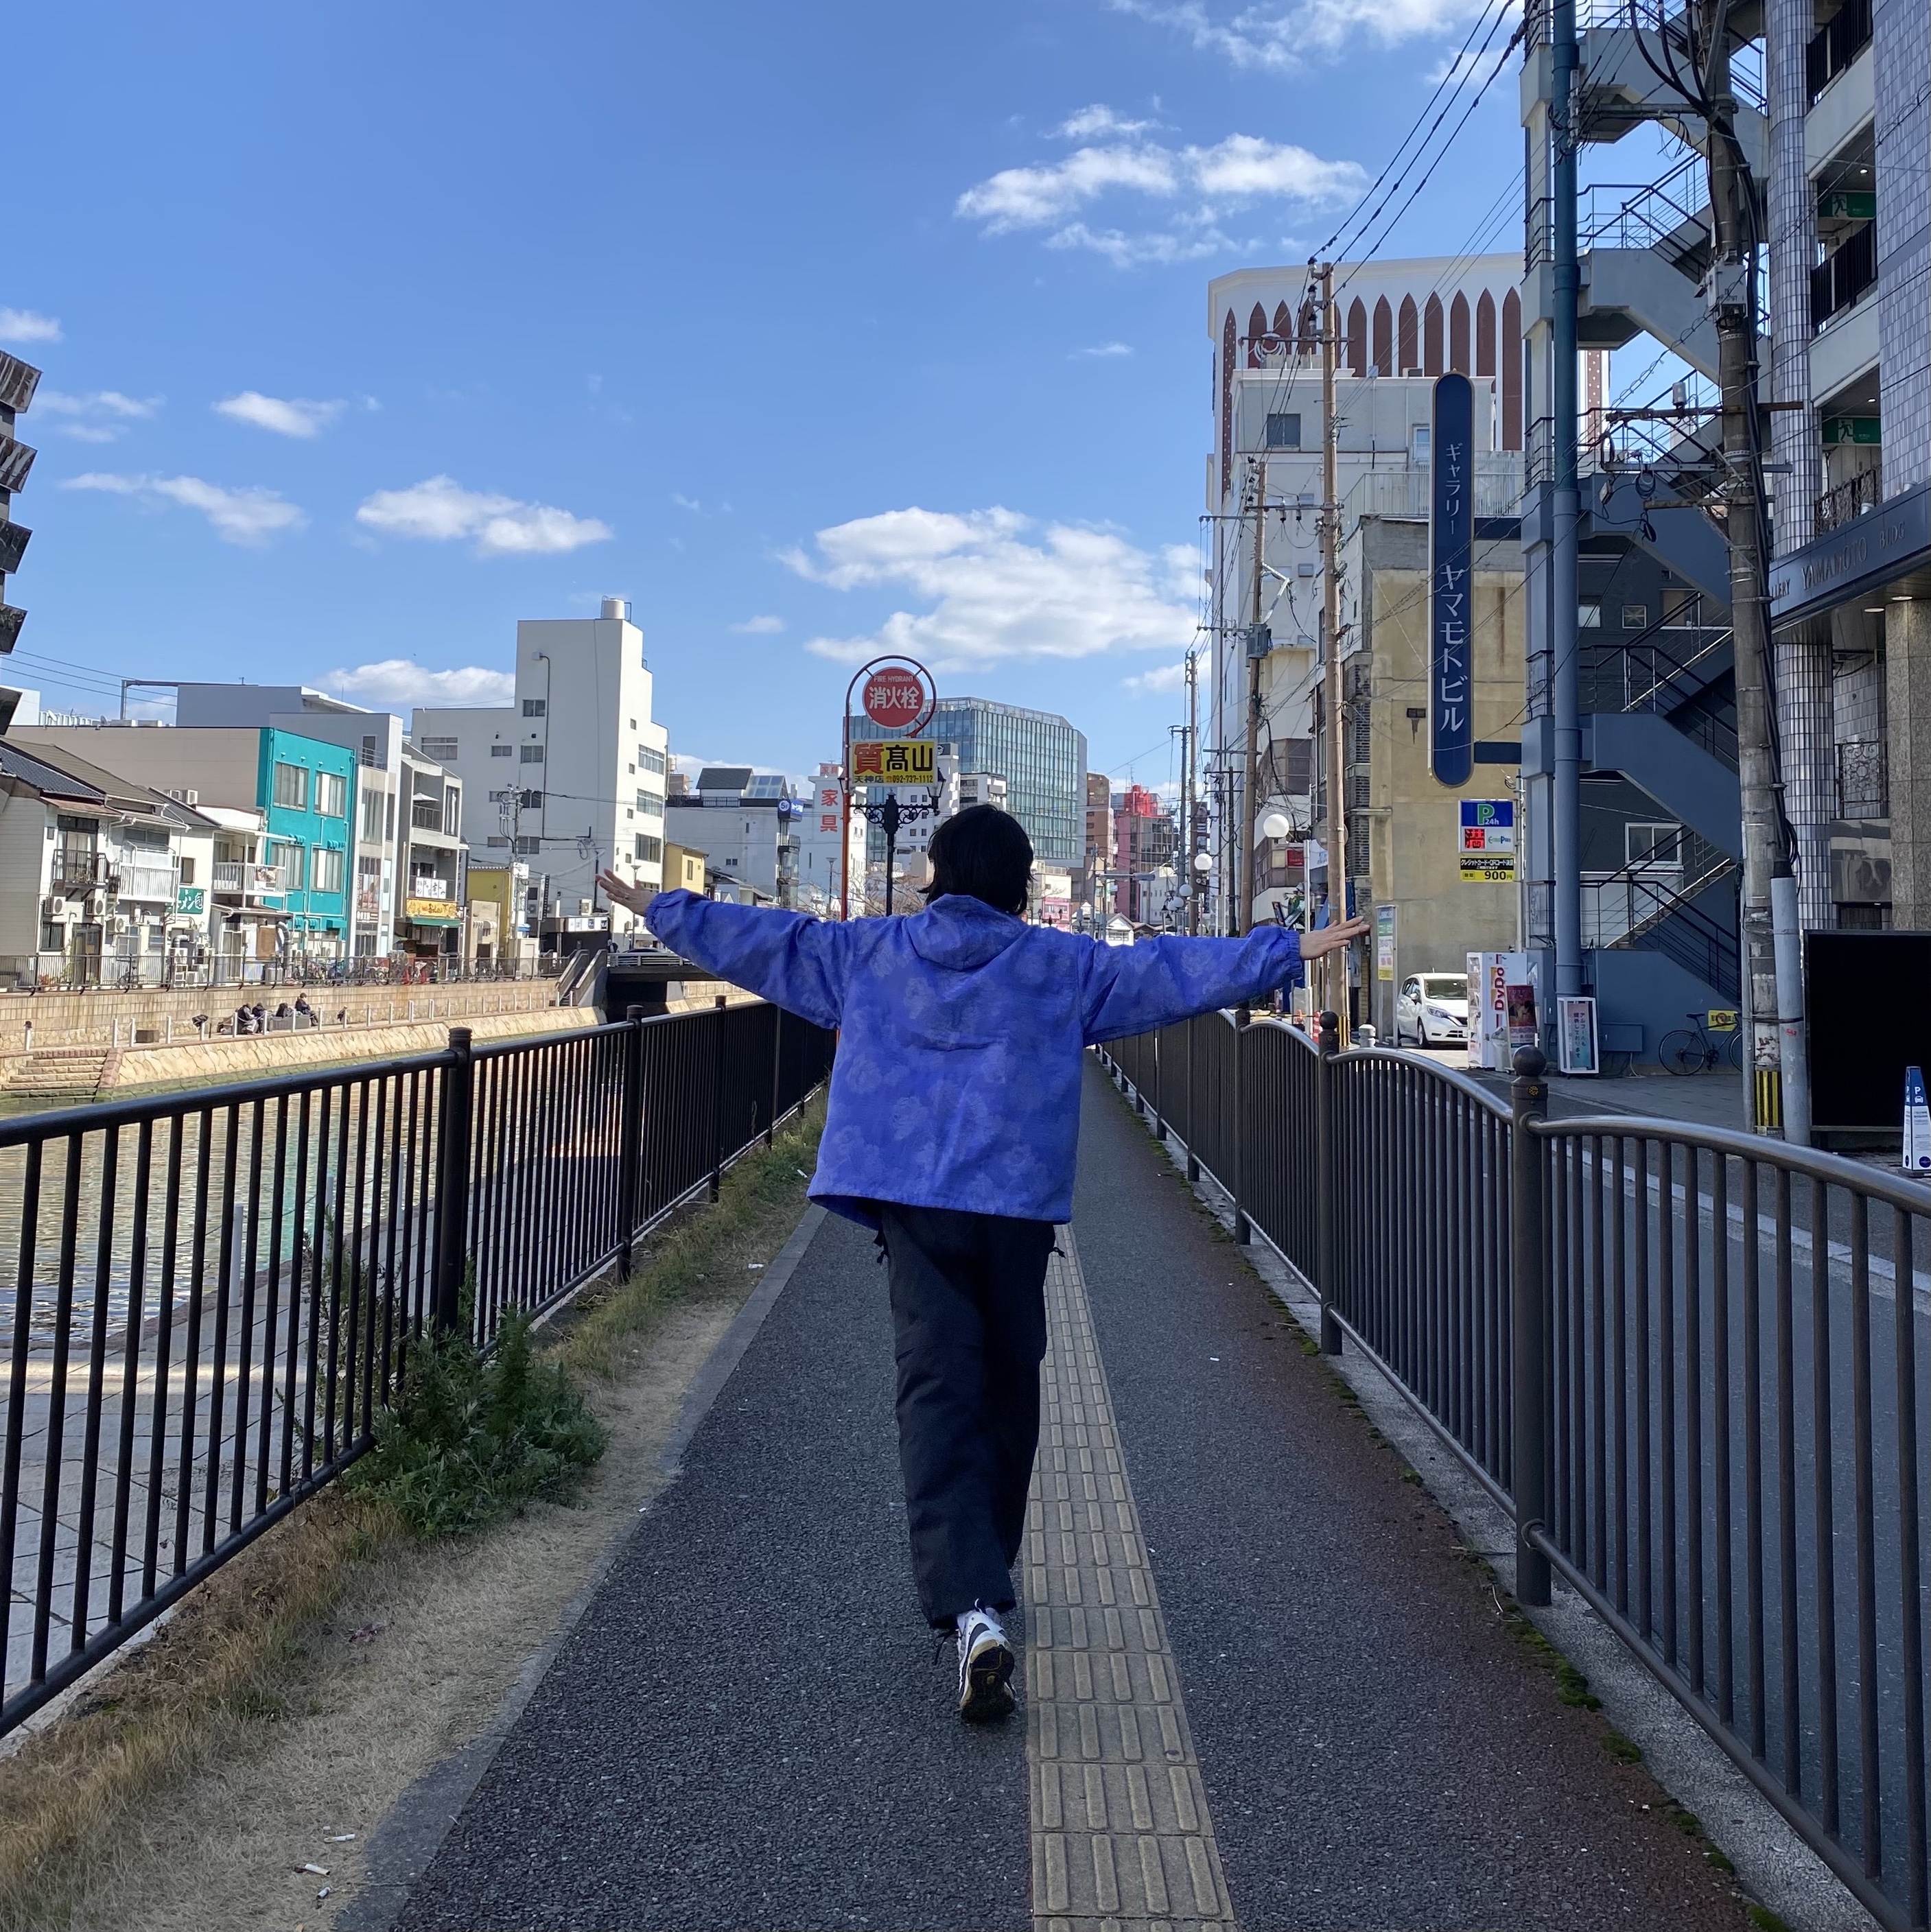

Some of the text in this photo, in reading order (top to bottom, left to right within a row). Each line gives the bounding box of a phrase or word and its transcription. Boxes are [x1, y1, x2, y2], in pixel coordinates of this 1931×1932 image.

[1770, 522, 1905, 599] LLERY YAMAMOTO BLDG
[1440, 443, 1468, 733] ギャラリー ヤマモトビル
[869, 686, 920, 709] 消火栓
[892, 775, 933, 783] 092-737-1112
[820, 789, 839, 832] 家具
[1477, 803, 1495, 825] P
[1464, 829, 1484, 849] 満
[1495, 967, 1505, 1011] DyDo
